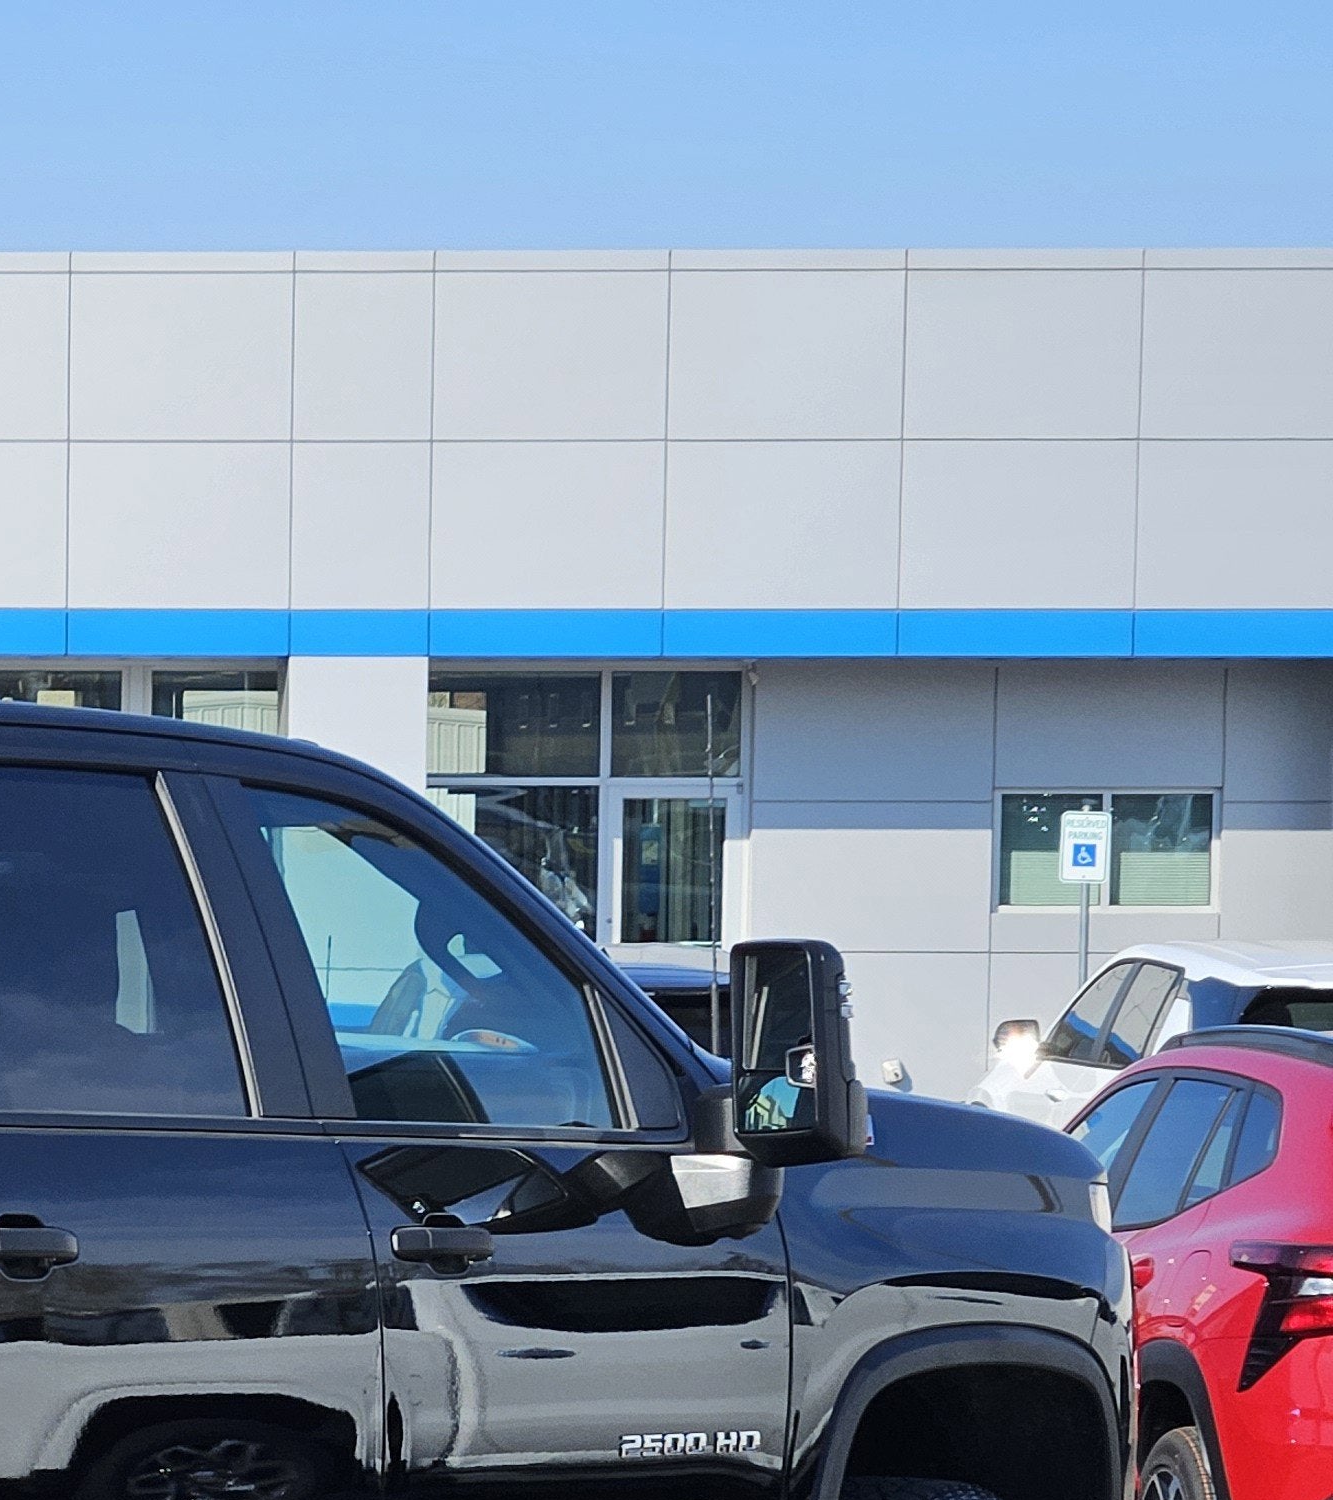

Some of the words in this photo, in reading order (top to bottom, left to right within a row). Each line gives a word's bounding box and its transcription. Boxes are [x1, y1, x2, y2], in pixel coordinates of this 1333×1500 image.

[1065, 819, 1107, 829] RESERVED
[1069, 831, 1103, 840] PARKING
[620, 1431, 708, 1458] 2500
[715, 1429, 761, 1454] HD
